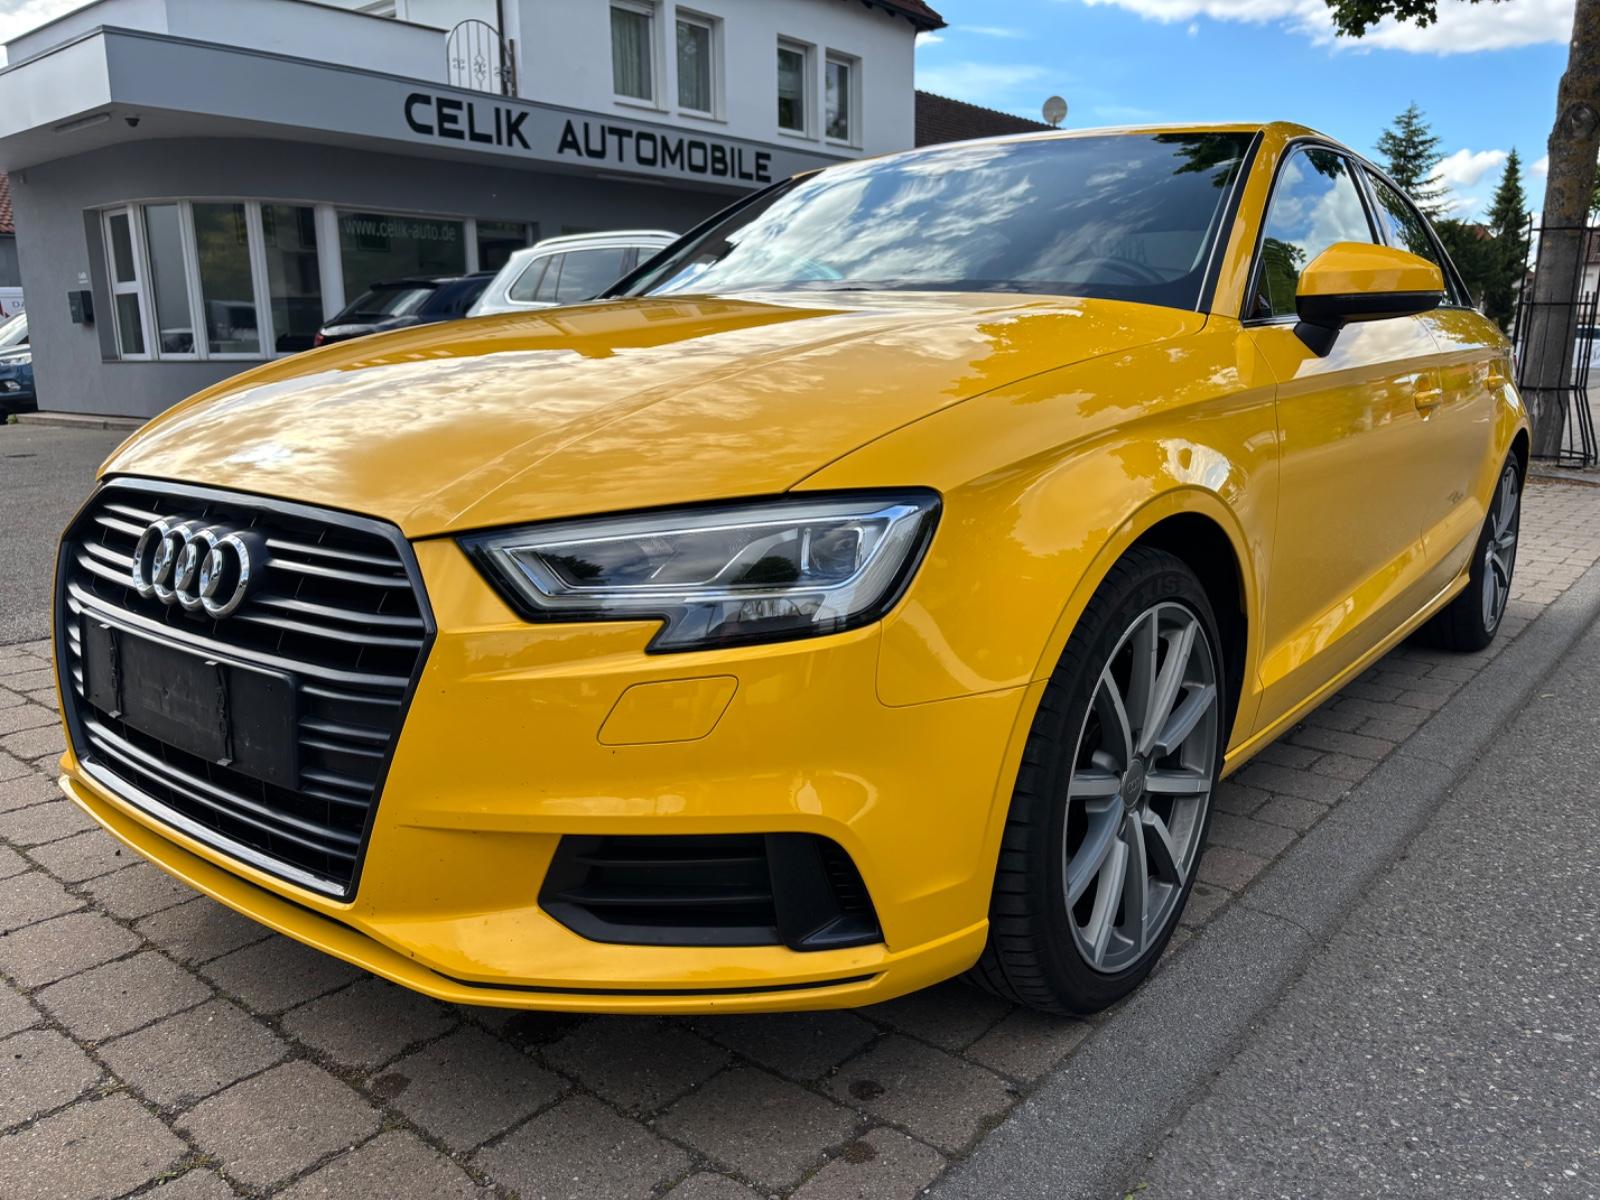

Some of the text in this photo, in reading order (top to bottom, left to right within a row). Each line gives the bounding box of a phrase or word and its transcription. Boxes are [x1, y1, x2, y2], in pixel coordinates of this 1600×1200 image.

[404, 92, 772, 183] CELIK AUTOMOBILE
[343, 218, 456, 242] www.celik-auto.de
